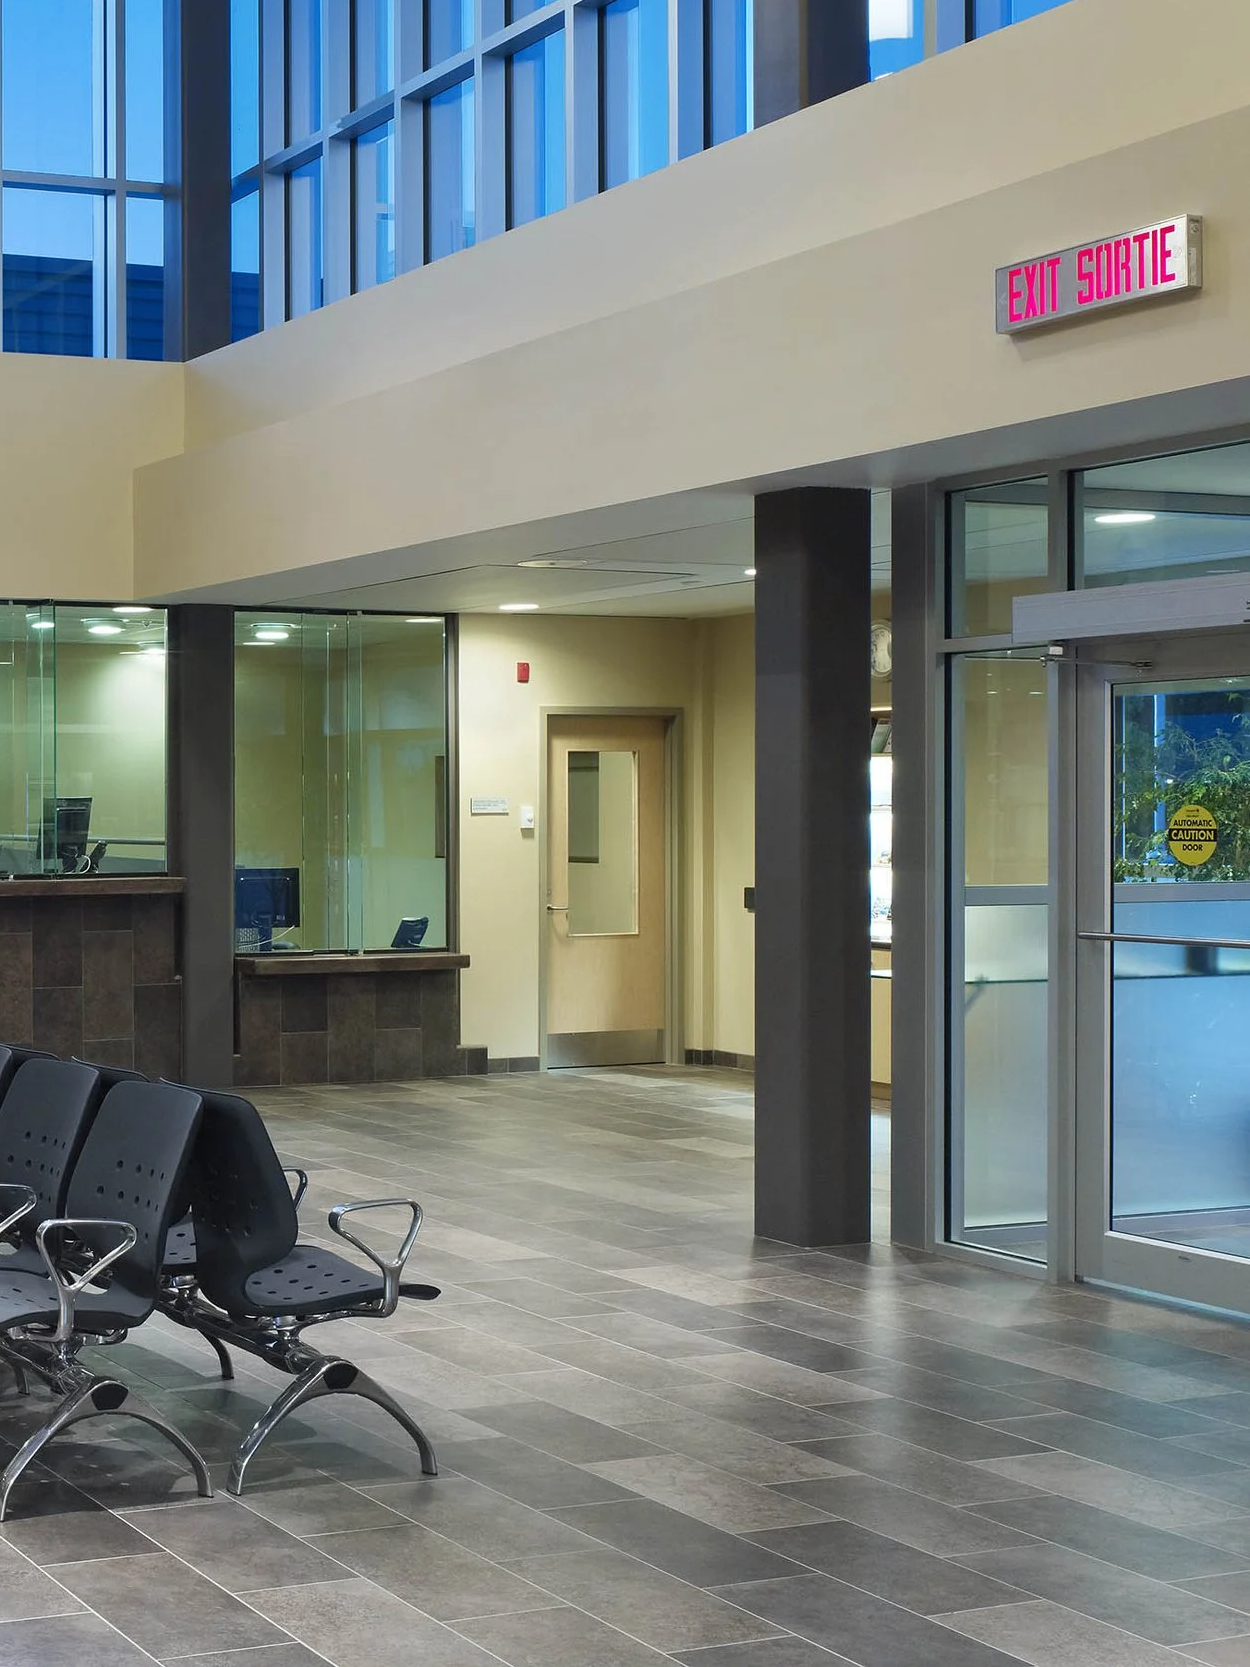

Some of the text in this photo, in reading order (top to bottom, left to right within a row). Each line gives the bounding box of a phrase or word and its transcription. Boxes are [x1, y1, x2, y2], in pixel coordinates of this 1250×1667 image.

[1008, 225, 1175, 322] EXIT SORTIE
[1173, 819, 1212, 827] AUTOMATIC
[1171, 830, 1214, 840] CAUTION
